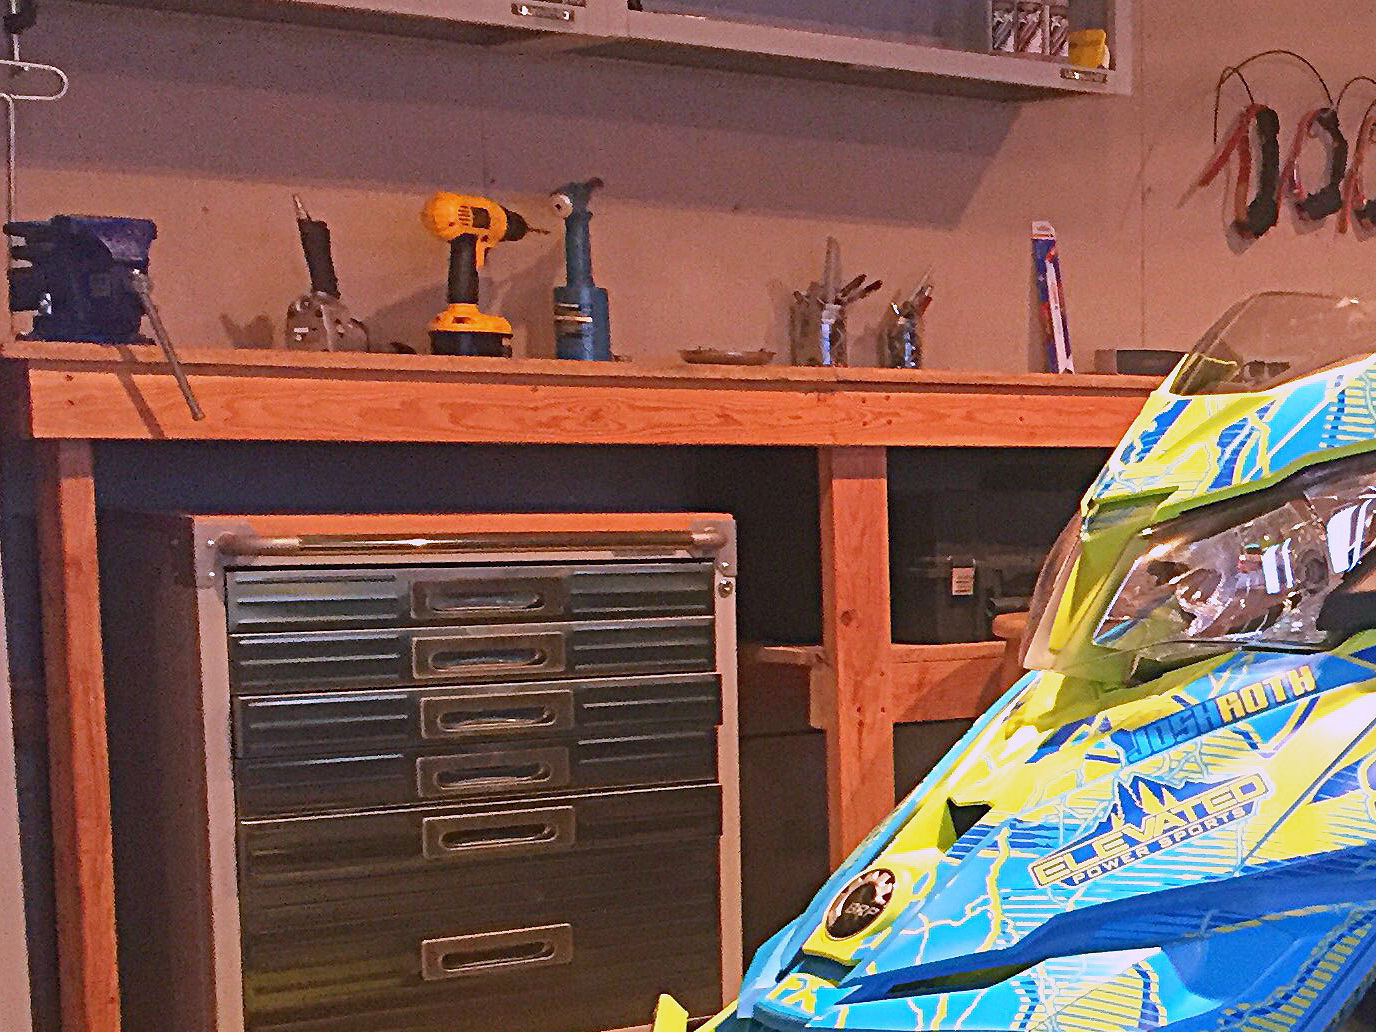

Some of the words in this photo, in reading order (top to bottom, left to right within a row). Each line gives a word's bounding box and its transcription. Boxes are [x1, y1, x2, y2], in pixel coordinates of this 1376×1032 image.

[1126, 701, 1222, 763] JOSH
[1216, 665, 1317, 723] ROTH
[1032, 771, 1270, 888] ELEVATED
[1072, 845, 1152, 885] POWER
[1158, 805, 1249, 853] SPORTS
